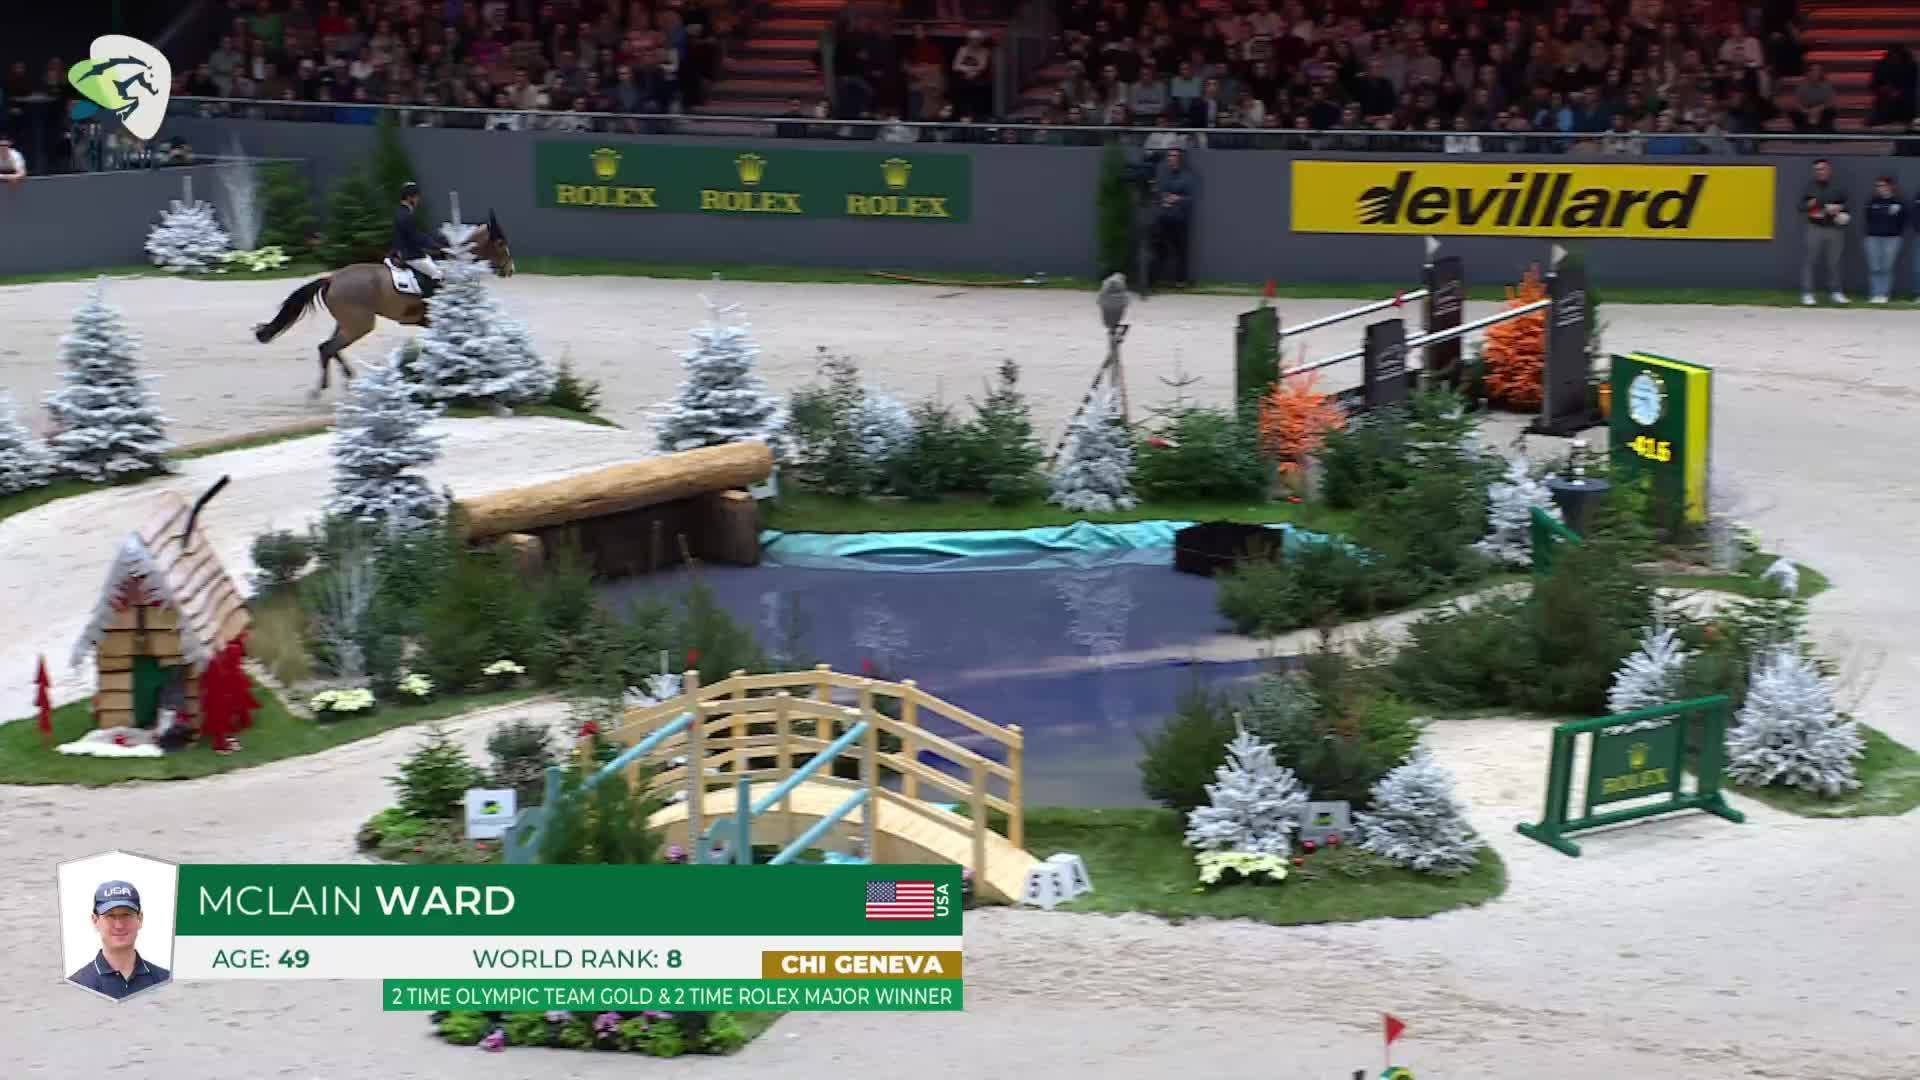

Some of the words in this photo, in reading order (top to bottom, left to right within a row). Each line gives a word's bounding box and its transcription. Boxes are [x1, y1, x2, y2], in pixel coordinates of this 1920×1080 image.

[556, 183, 658, 208] ROLEX
[700, 189, 803, 214] ROLEX
[846, 193, 950, 218] ROLEX
[1357, 171, 1708, 229] devillard
